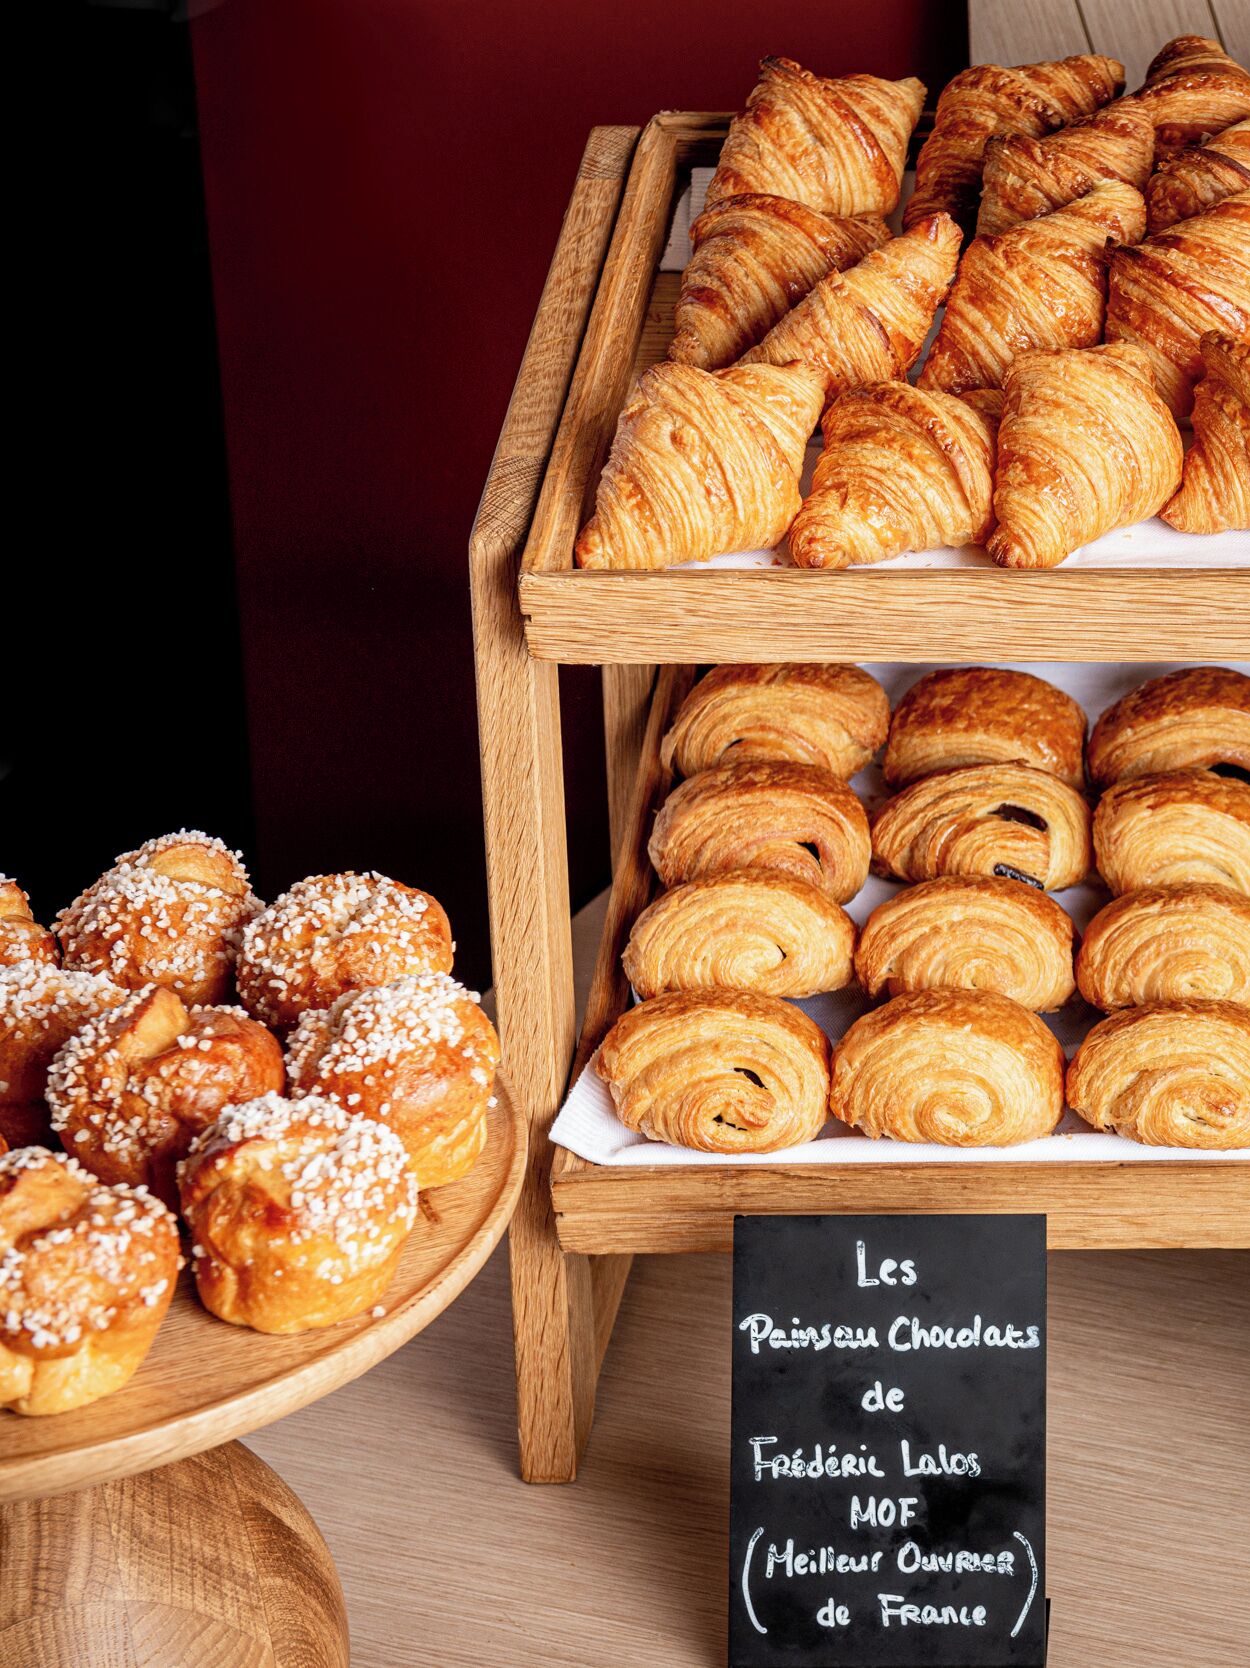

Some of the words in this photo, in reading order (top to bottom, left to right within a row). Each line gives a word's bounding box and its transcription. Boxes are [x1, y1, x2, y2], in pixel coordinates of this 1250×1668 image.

[856, 1239, 918, 1288] Les
[887, 1314, 1041, 1352] Chocolats
[860, 1380, 905, 1413] de
[900, 1439, 982, 1478] Lalos
[850, 1495, 919, 1530] MOF
[816, 1597, 853, 1628] de
